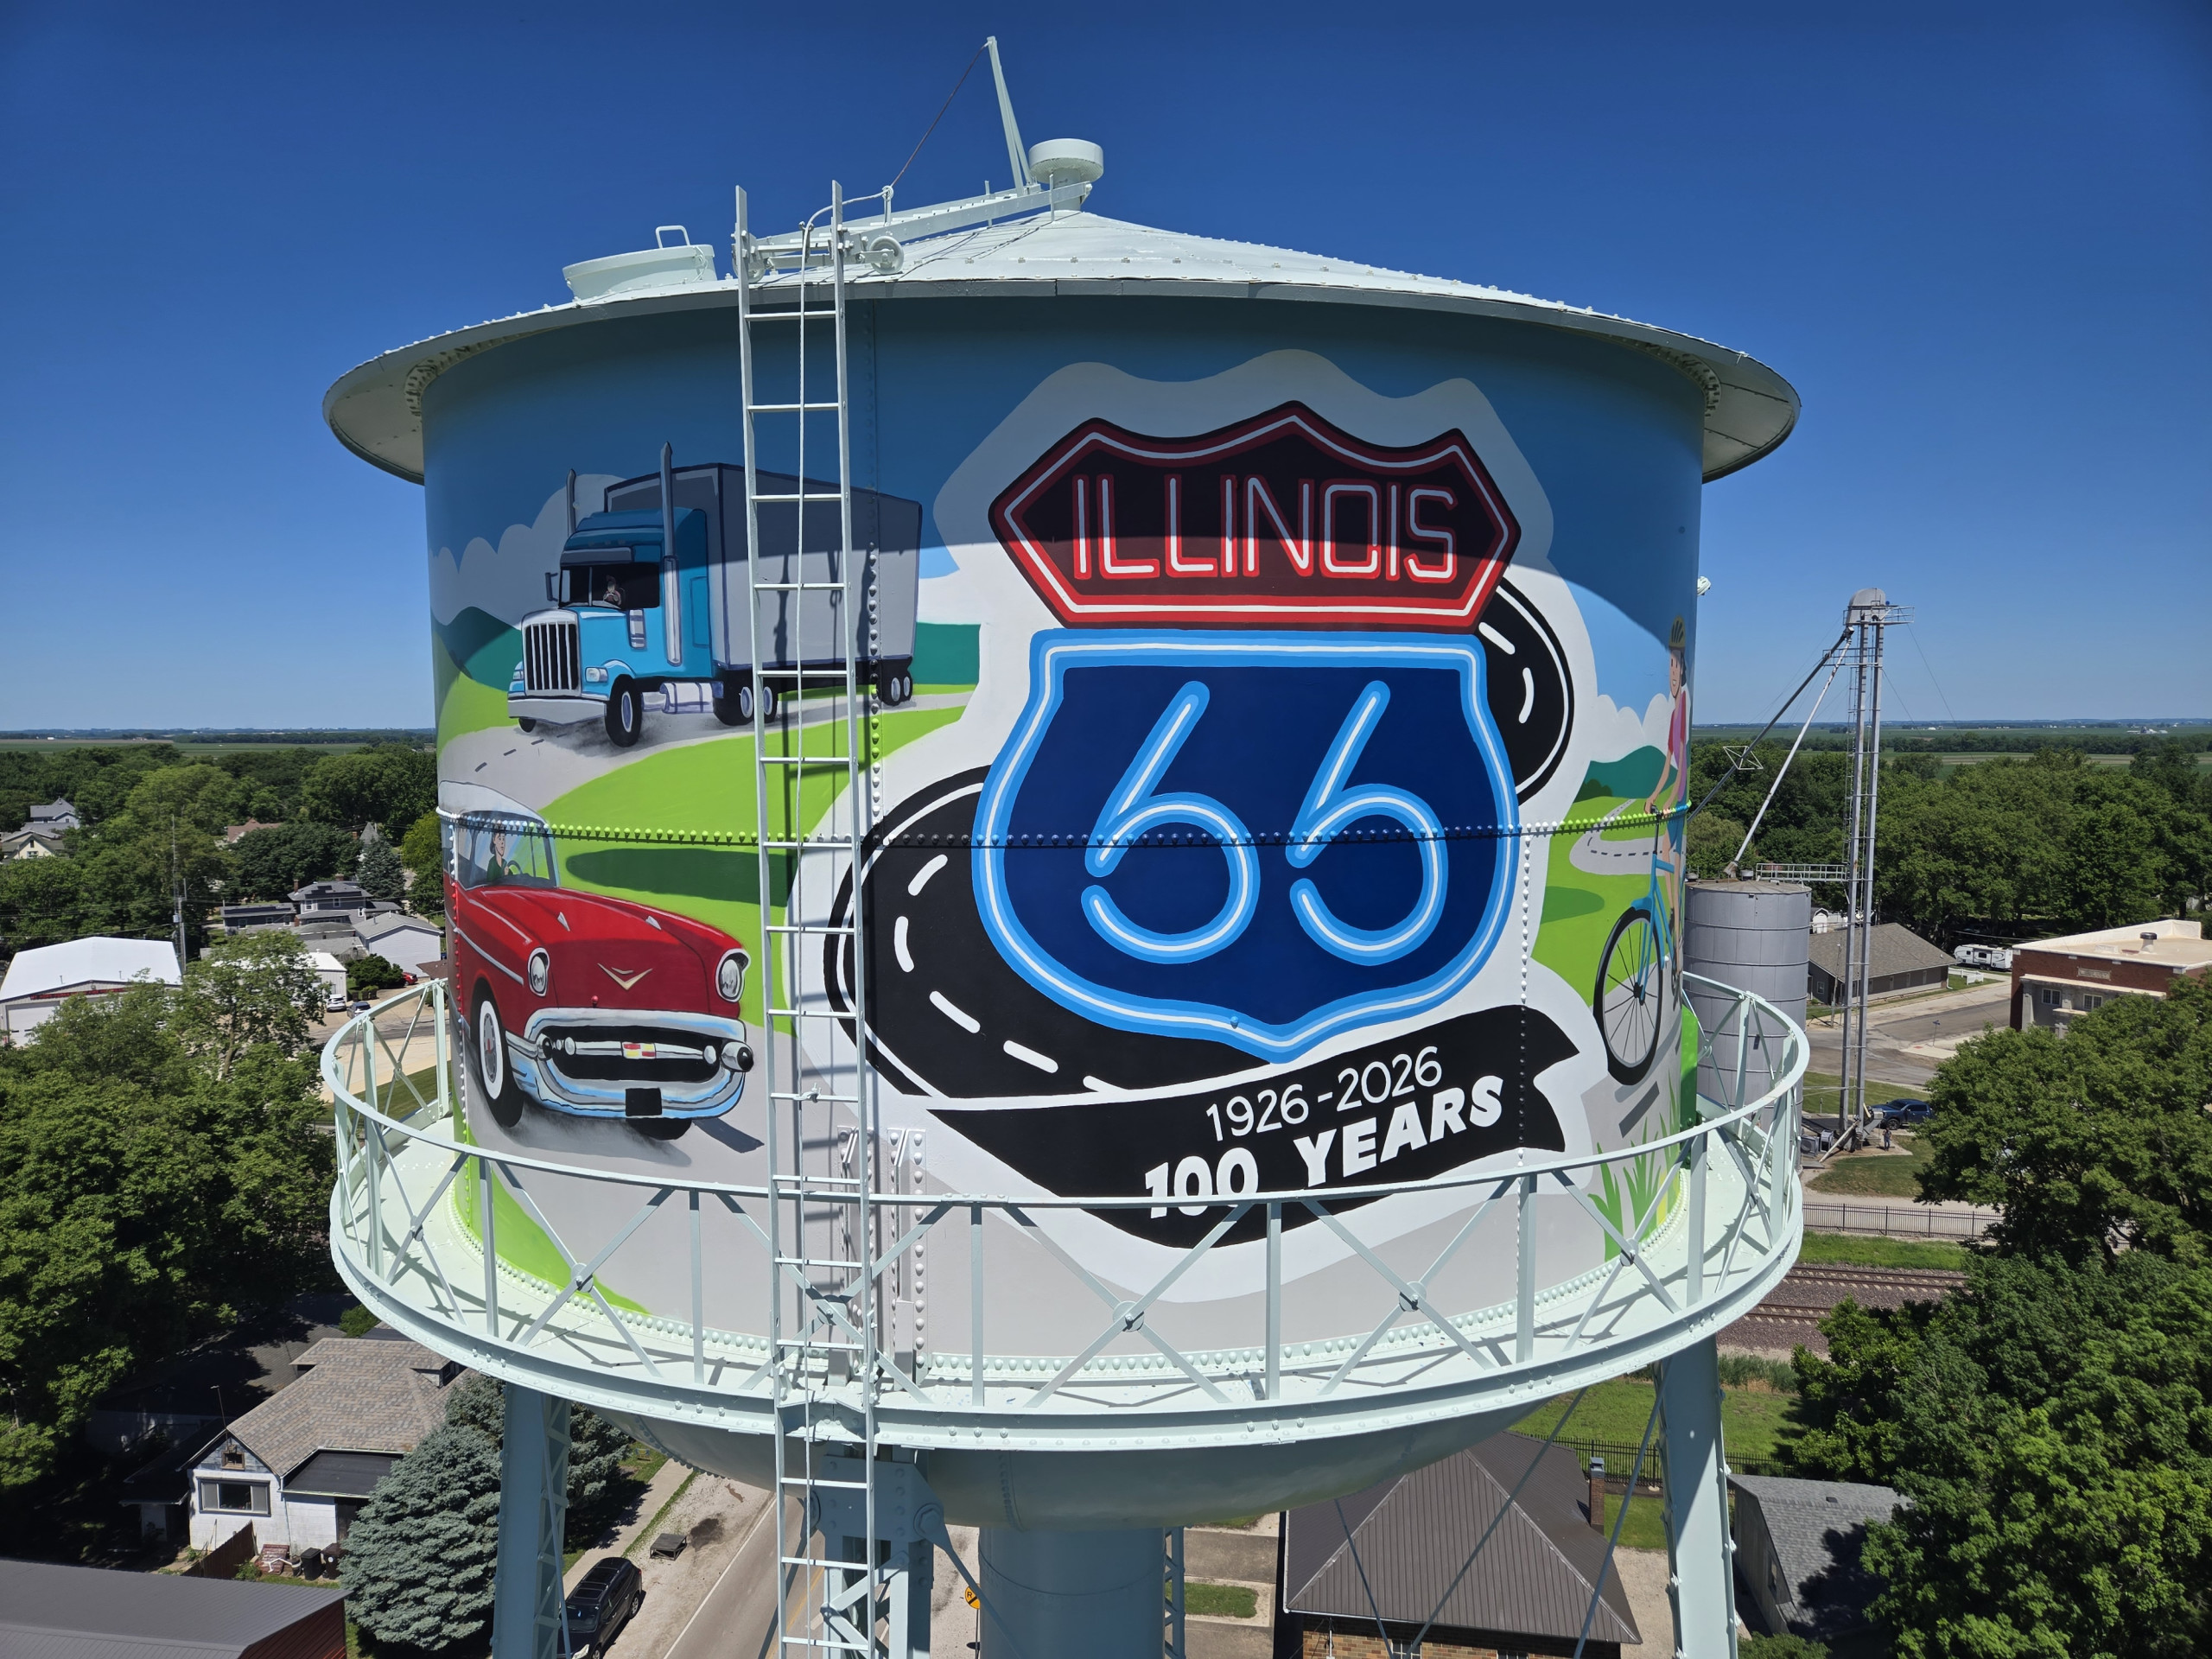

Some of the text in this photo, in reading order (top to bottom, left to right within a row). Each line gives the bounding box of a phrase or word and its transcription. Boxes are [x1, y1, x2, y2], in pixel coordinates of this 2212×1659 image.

[1072, 474, 1459, 582] ILLINOIS
[1081, 680, 1448, 966] 66
[1145, 1075, 1504, 1219] 100 YEARS
